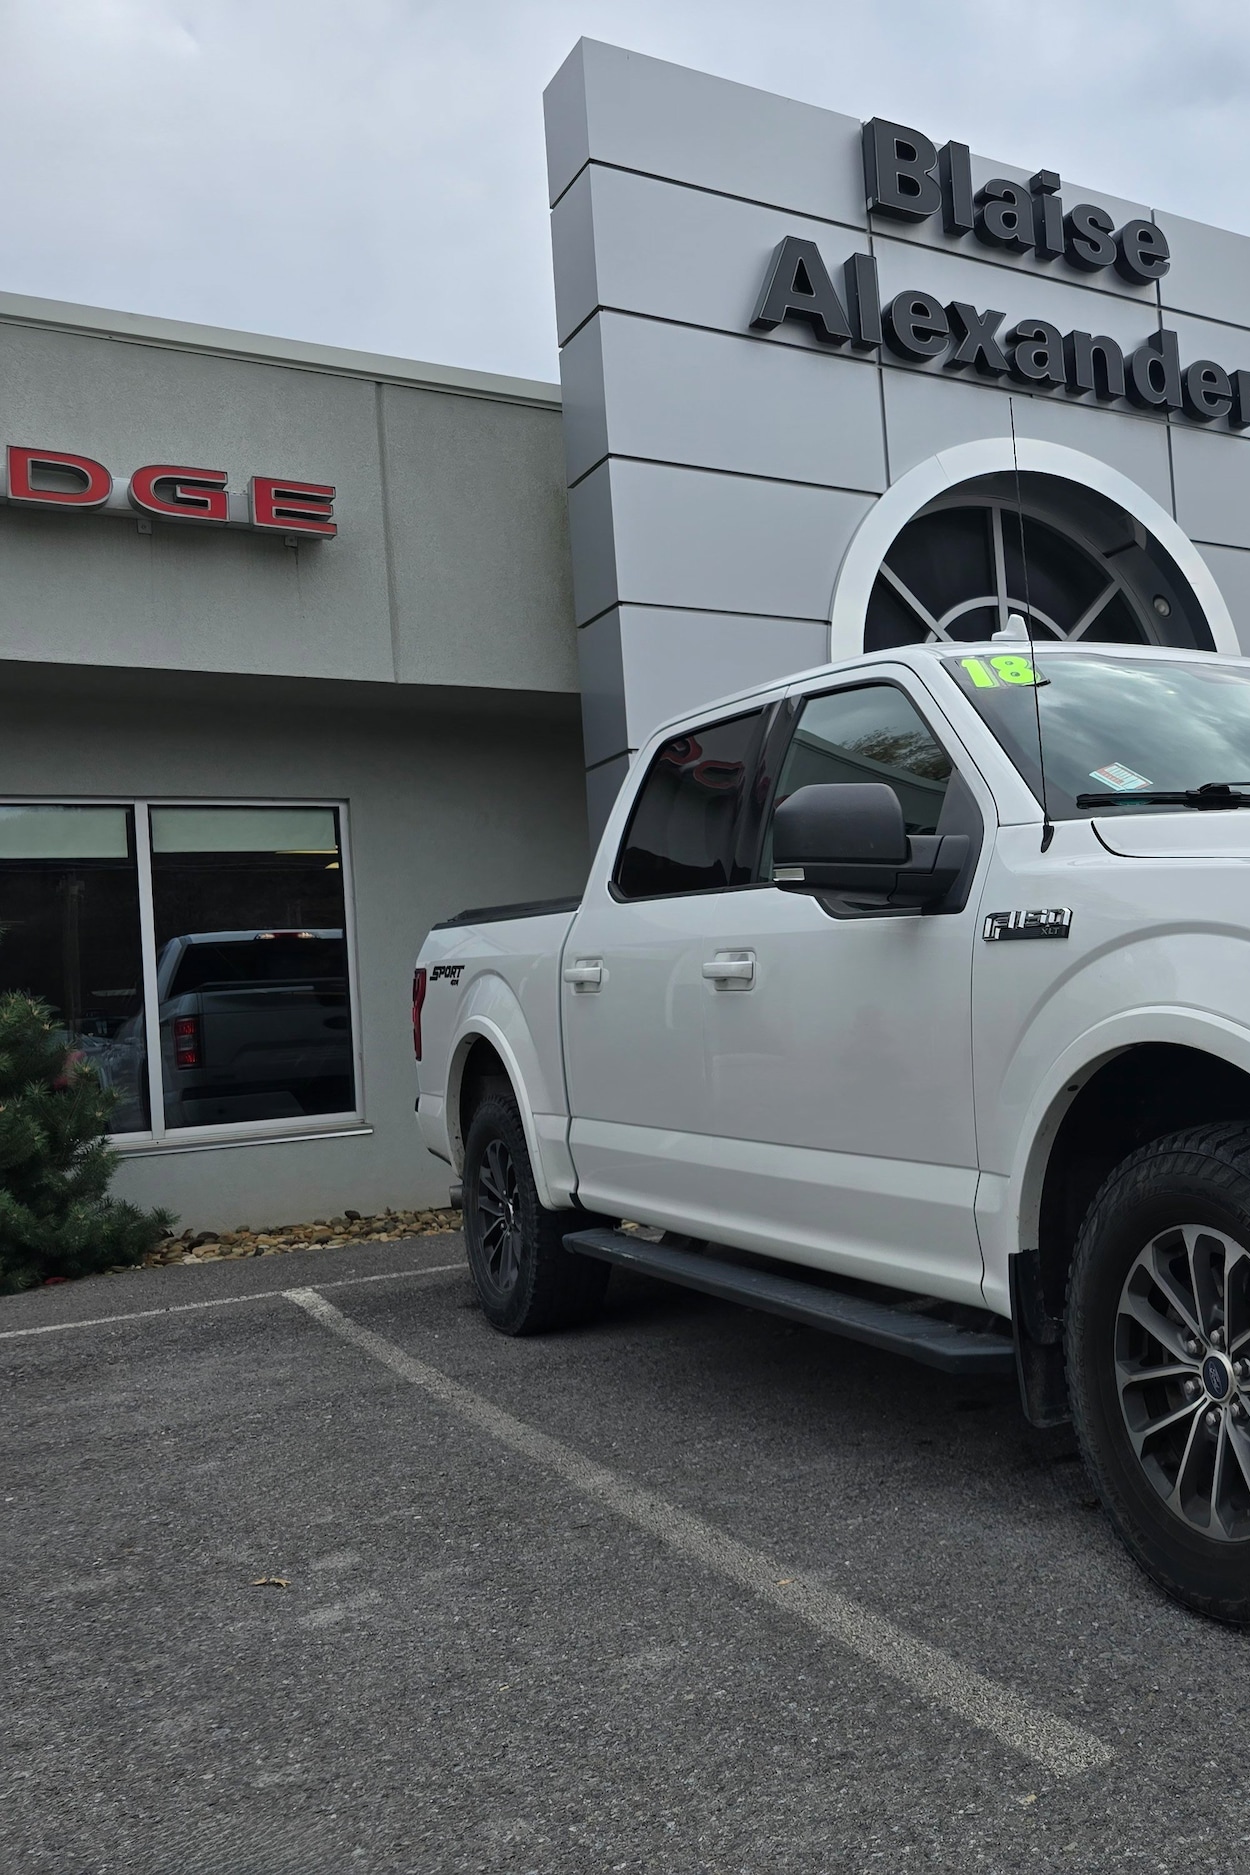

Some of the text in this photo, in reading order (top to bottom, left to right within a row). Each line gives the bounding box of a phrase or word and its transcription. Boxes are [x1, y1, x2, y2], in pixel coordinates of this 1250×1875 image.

[862, 117, 1170, 287] Blaise
[961, 655, 1041, 688] 18
[430, 965, 465, 981] SPORT
